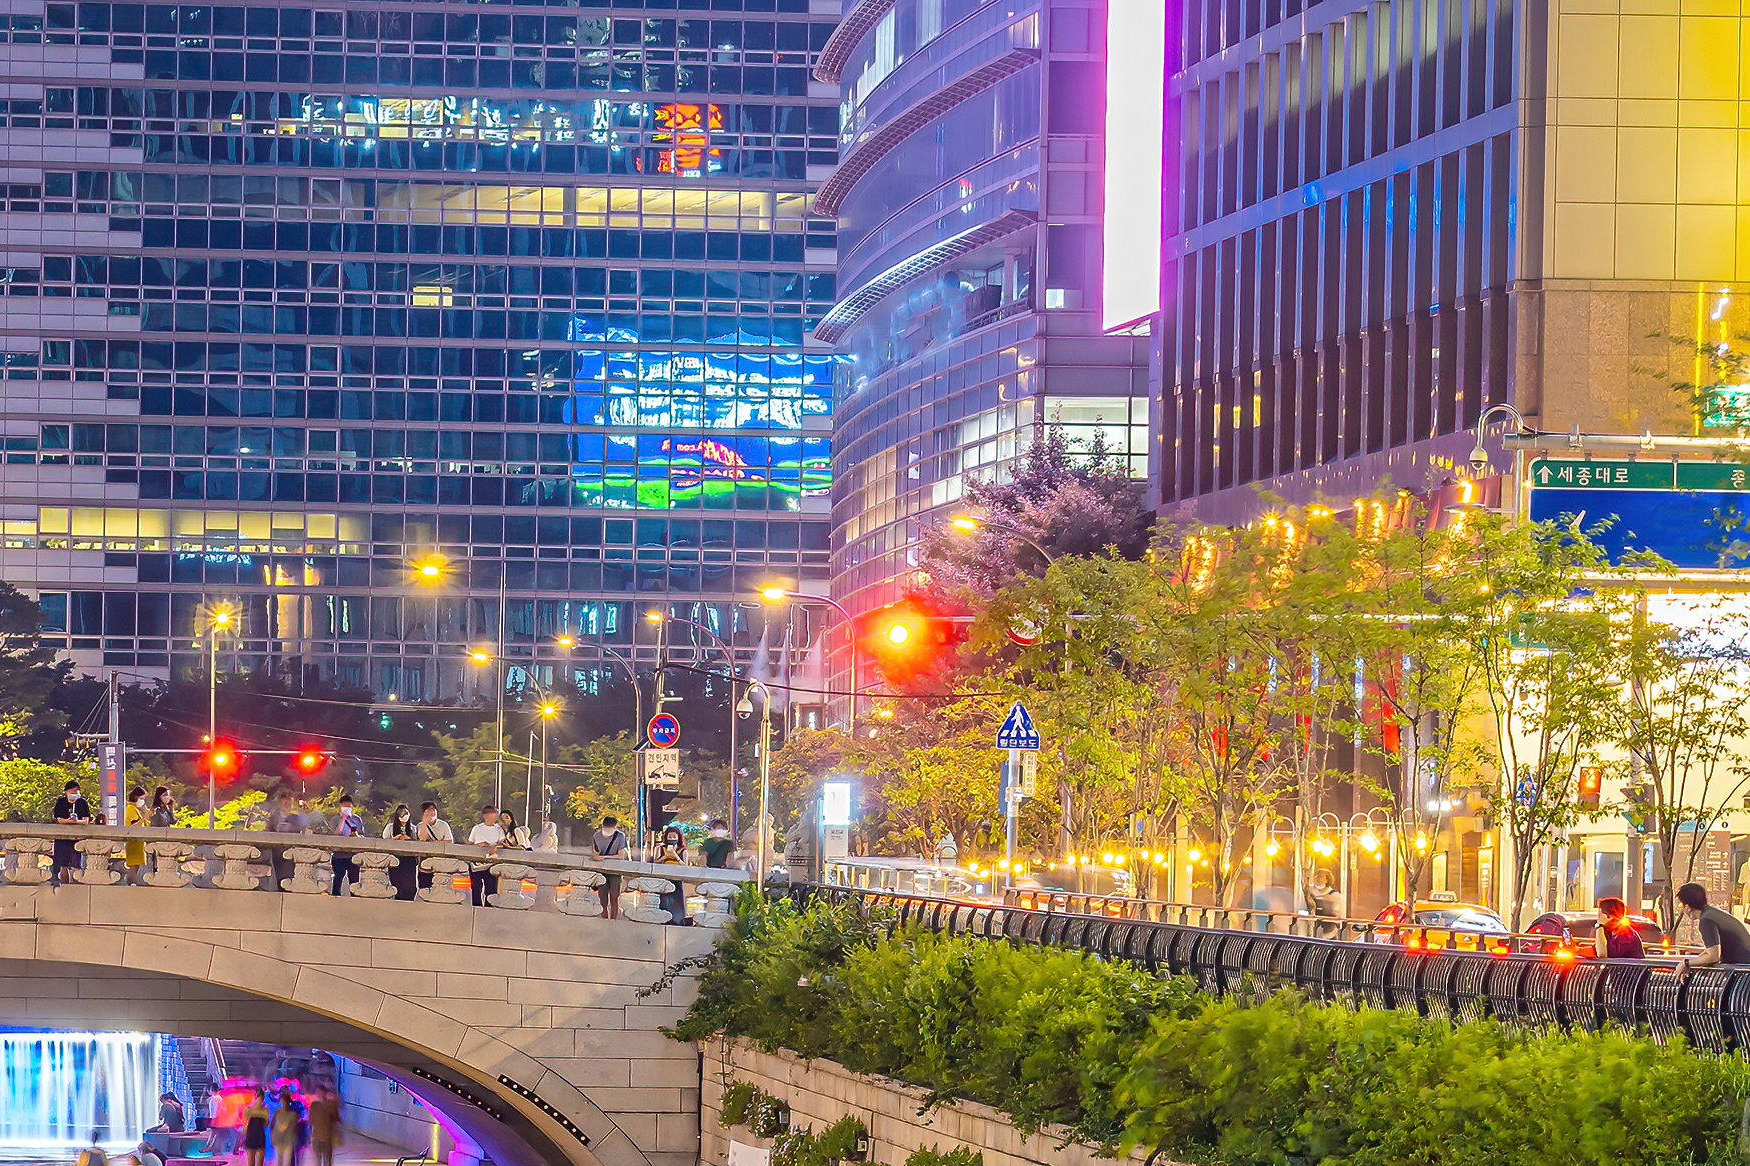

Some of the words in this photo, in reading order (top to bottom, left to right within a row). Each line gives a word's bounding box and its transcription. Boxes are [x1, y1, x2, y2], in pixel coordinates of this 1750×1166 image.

[1557, 466, 1629, 486] 세종대로
[1000, 738, 1037, 748] 횡단보도
[648, 753, 677, 763] 견인지역
